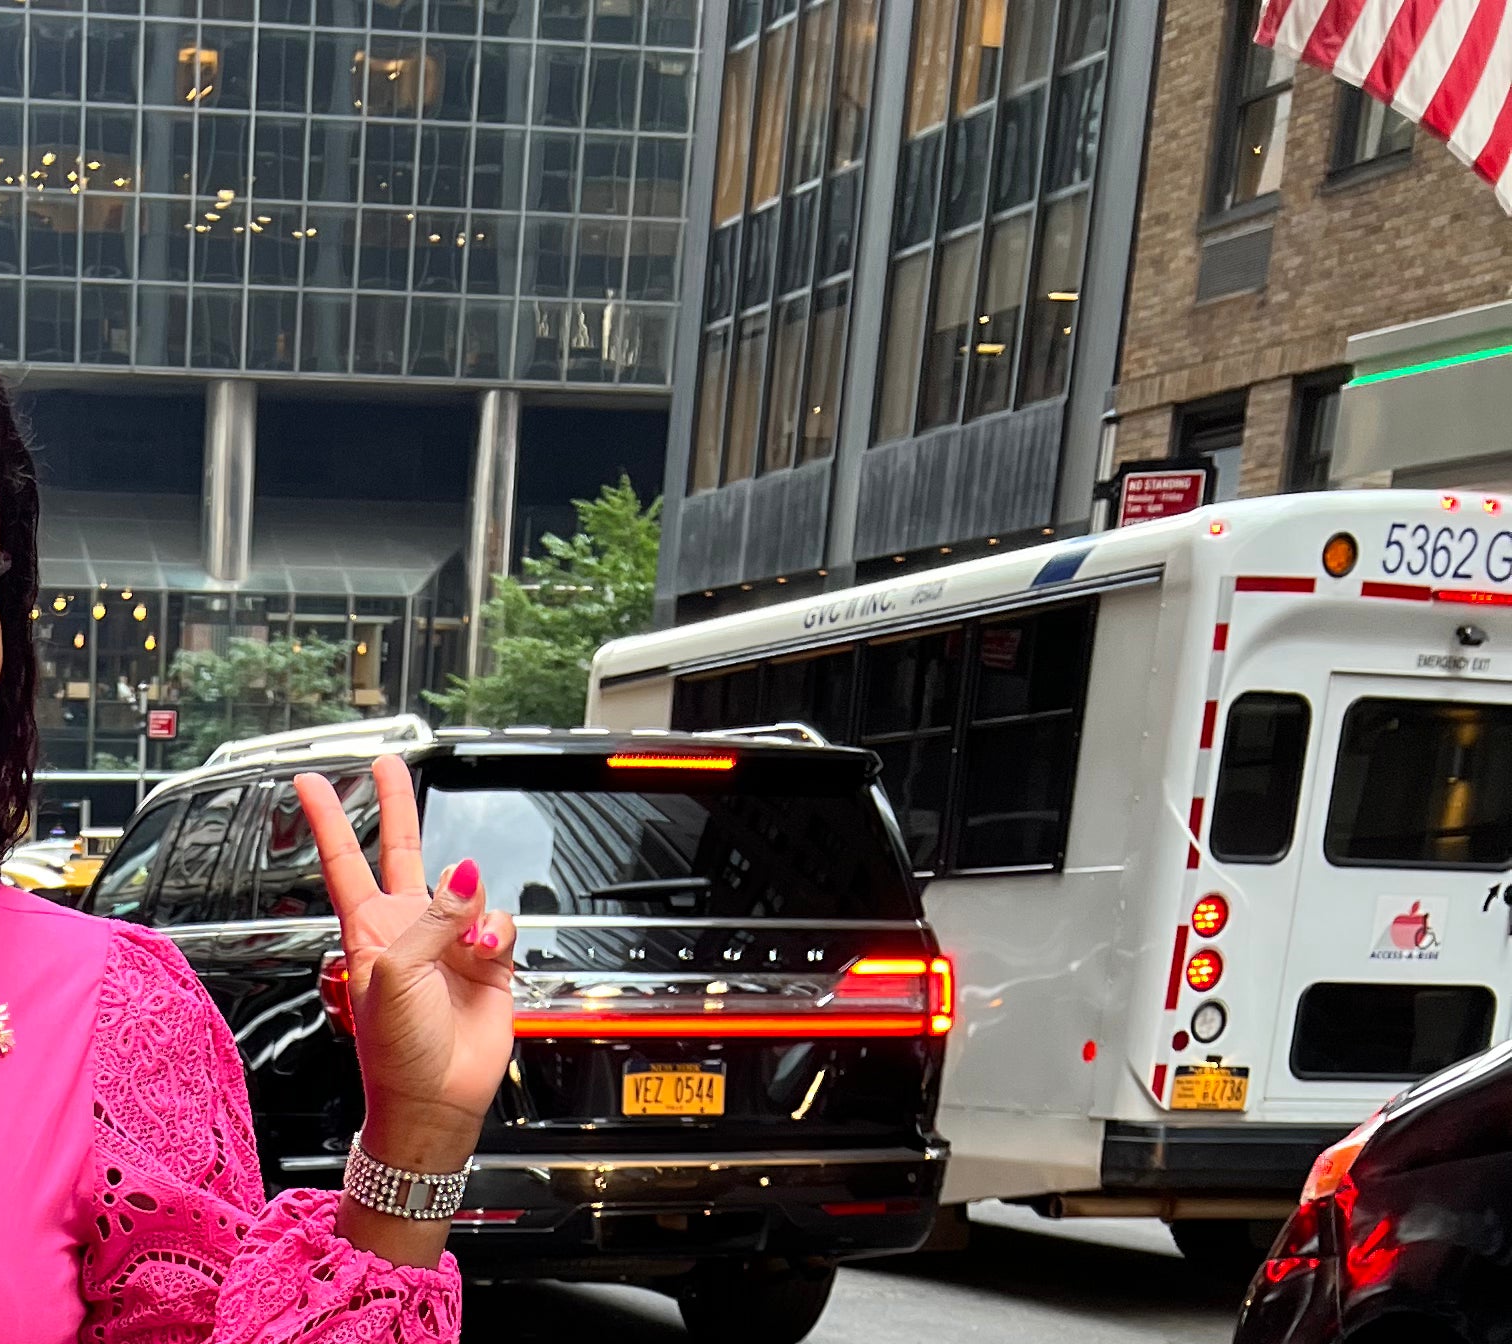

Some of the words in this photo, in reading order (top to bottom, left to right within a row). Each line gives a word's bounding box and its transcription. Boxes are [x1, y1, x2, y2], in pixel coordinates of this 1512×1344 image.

[1128, 480, 1143, 492] NO
[1144, 477, 1192, 491] STANDING
[1382, 522, 1478, 579] 5362
[1417, 653, 1469, 672] EMERGENCY
[1471, 657, 1491, 672] EXIT
[541, 943, 825, 963] LINCOLN
[634, 1076, 664, 1104] VEZ
[674, 1076, 714, 1104] 0544
